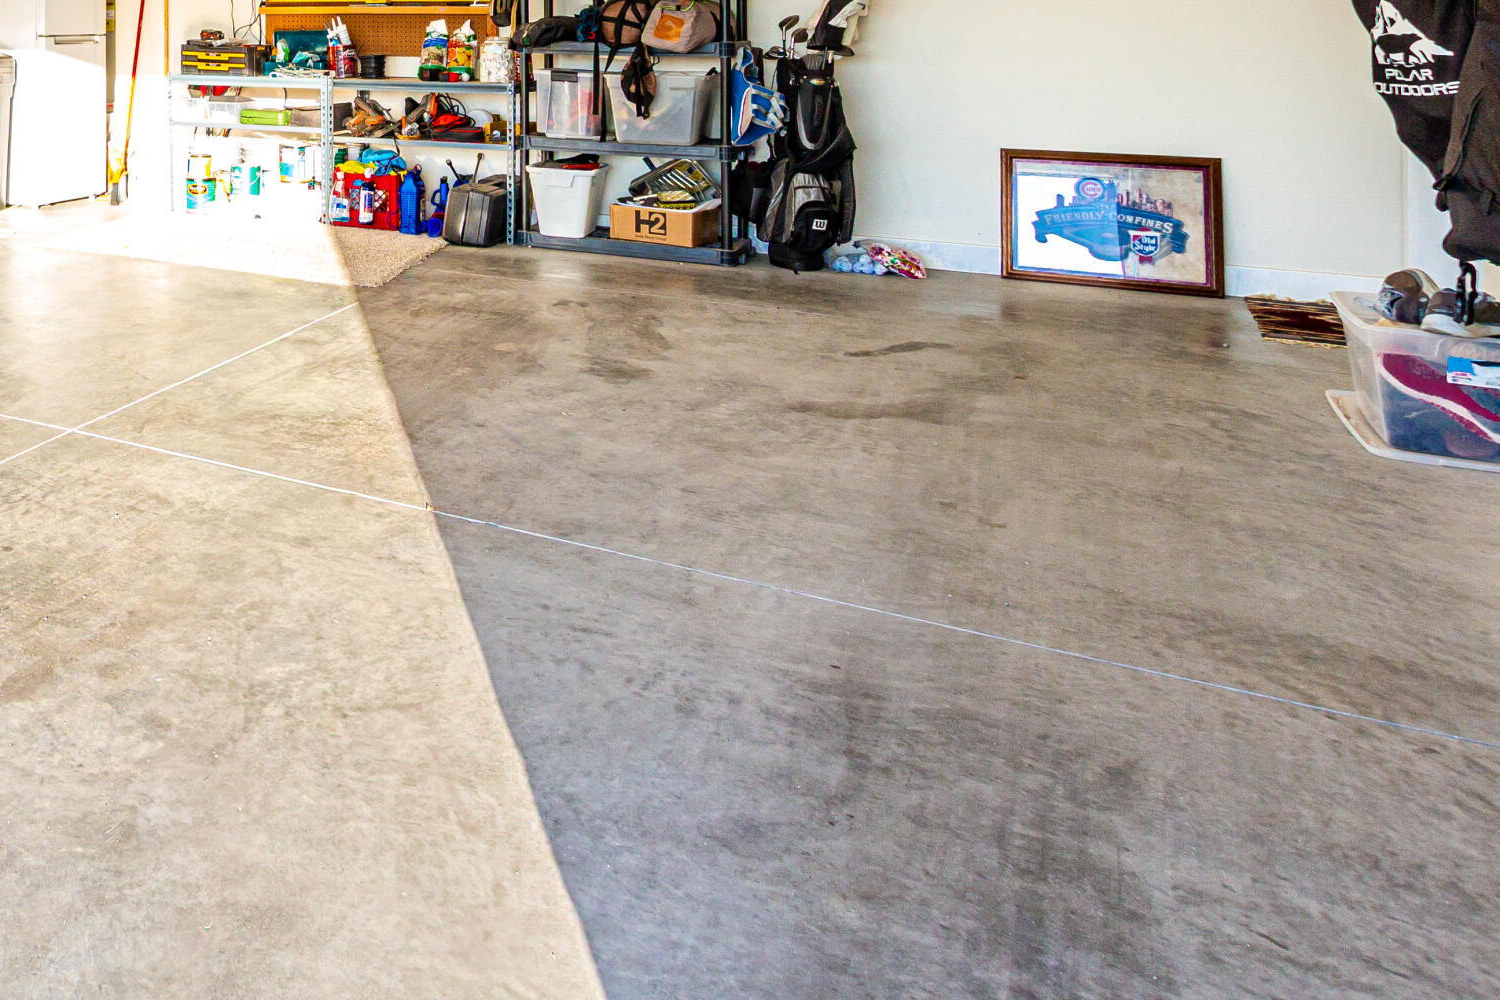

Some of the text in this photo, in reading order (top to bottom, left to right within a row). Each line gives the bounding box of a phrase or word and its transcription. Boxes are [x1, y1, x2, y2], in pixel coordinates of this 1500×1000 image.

[1373, 80, 1461, 96] OUTDOORS
[635, 210, 667, 236] H2
[1043, 210, 1174, 234] FRIENDLY CONFINES
[1134, 241, 1156, 254] Style
[1141, 236, 1156, 245] Old
